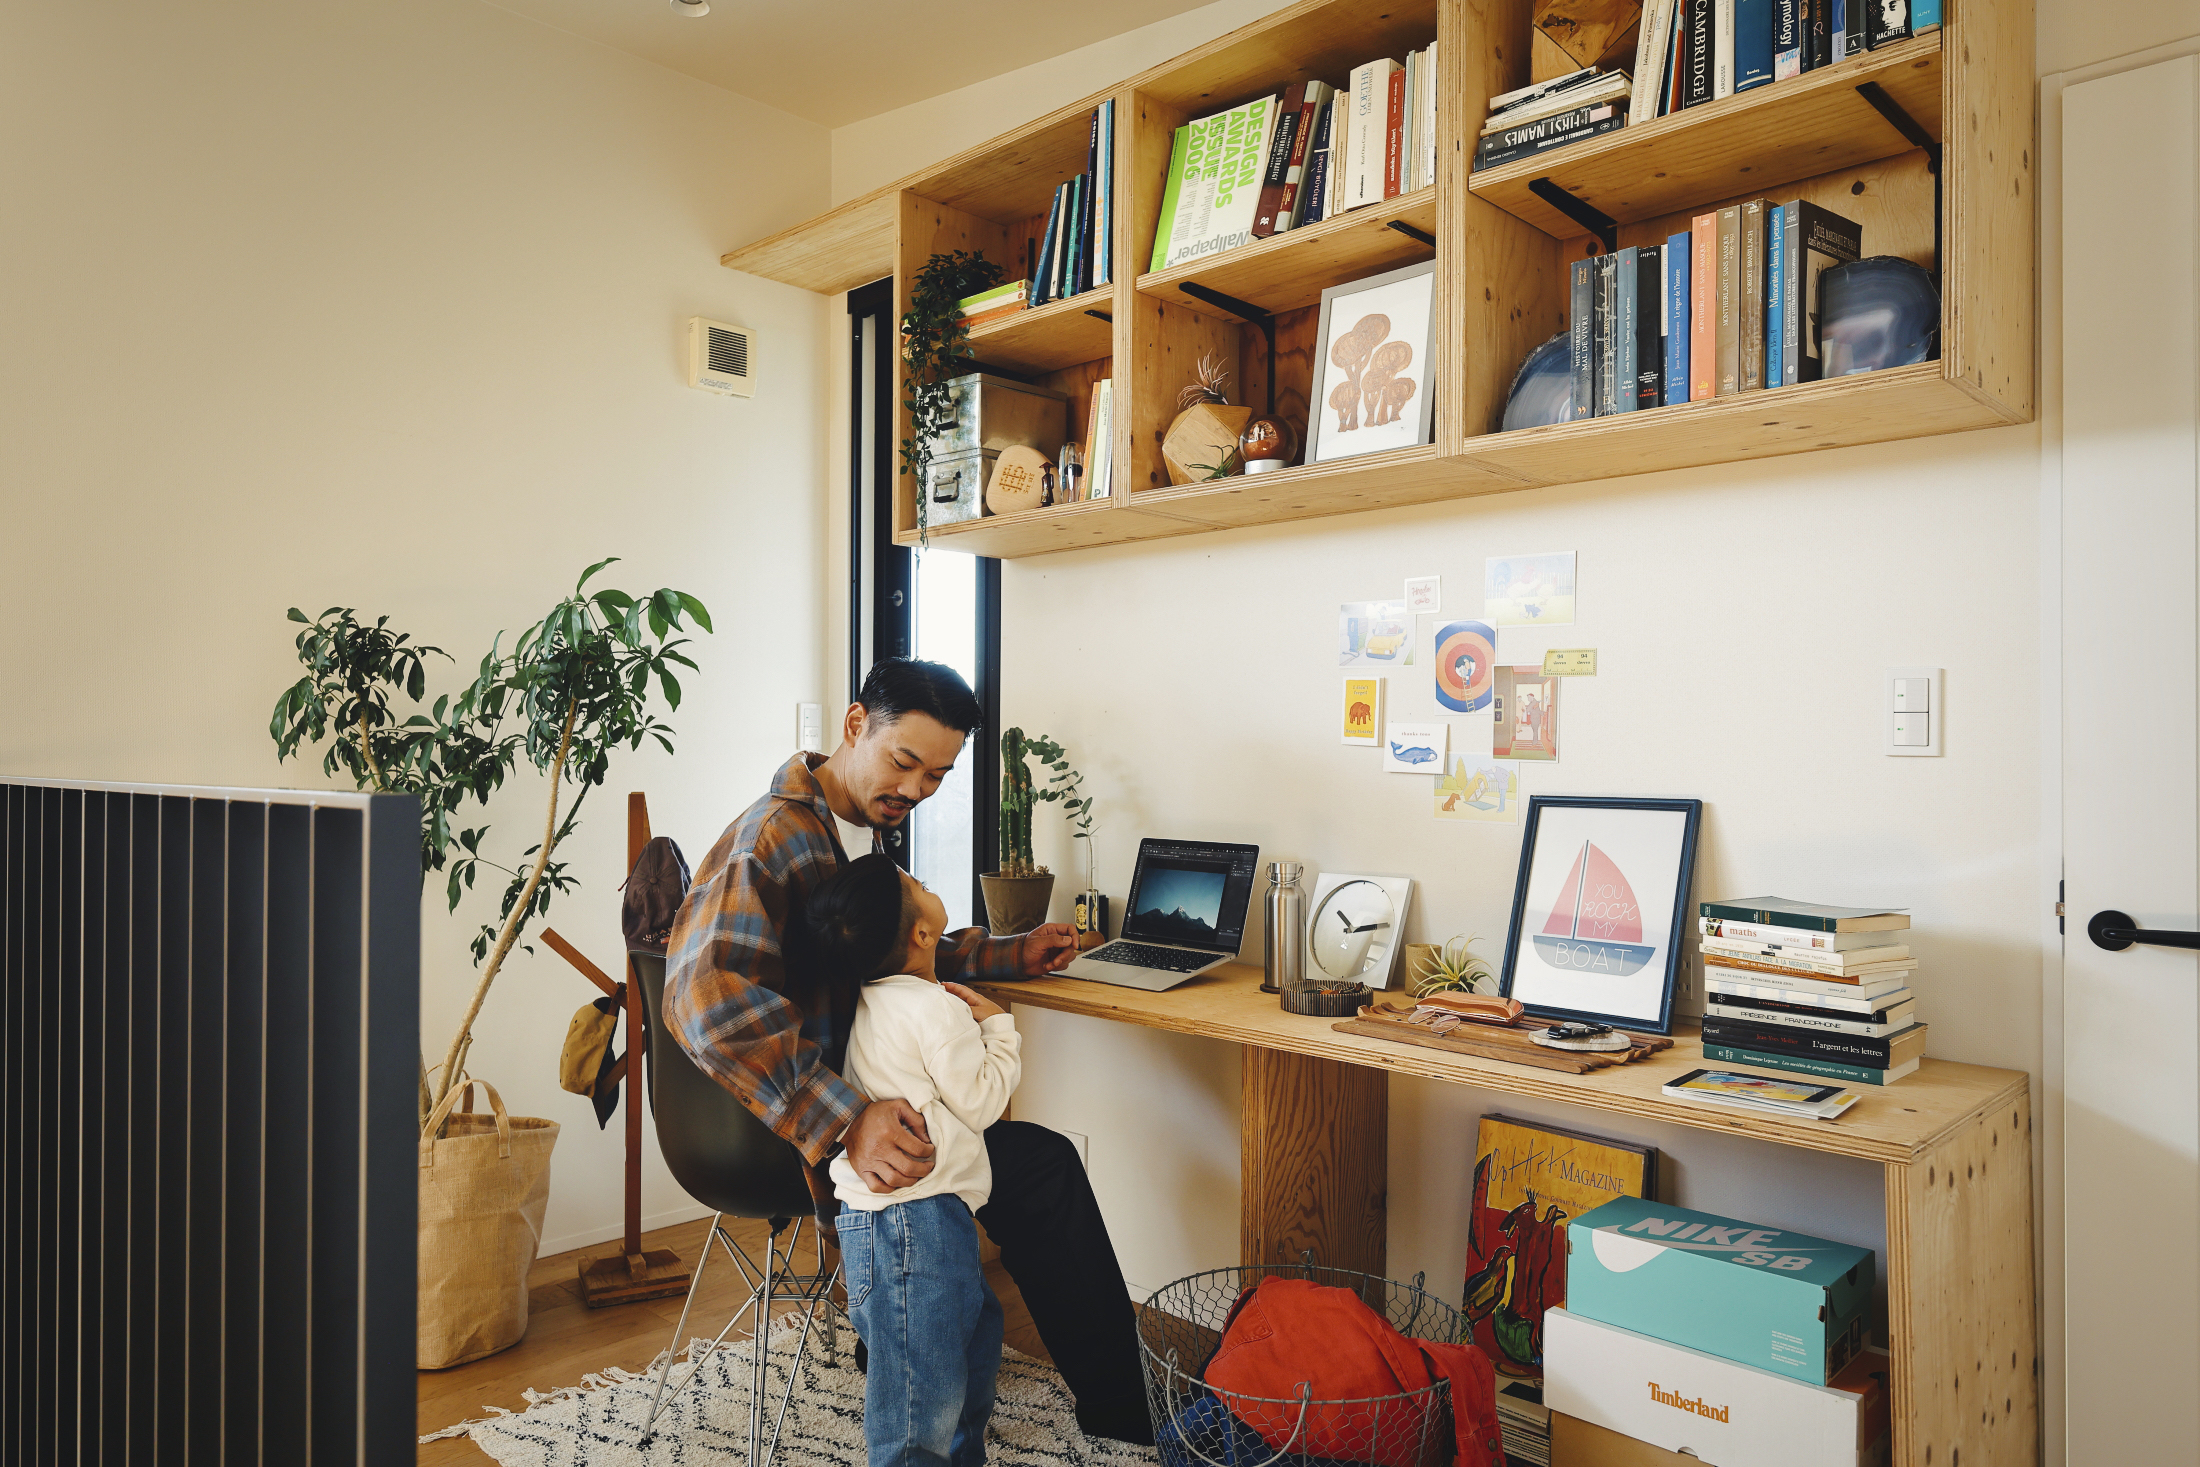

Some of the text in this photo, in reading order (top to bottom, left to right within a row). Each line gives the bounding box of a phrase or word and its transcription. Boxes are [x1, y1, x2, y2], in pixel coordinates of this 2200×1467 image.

[1779, 0, 1794, 44] ymology
[1875, 26, 1906, 41] HACHETTE
[1693, 0, 1707, 96] CAMBRIDGE
[1359, 69, 1370, 116] GOETHE
[1635, 72, 1646, 118] DIALOGUES
[1237, 99, 1268, 188] DESIGN
[1501, 114, 1582, 147] FIRST NAMES
[1184, 121, 1209, 181] 2006
[1200, 114, 1228, 183] ISSUE
[1214, 111, 1247, 209] AWARDS
[1768, 212, 1781, 308] Minorités dans la pensée
[1673, 268, 1681, 287] l'histoire
[1673, 296, 1681, 310] règne
[1581, 314, 1589, 339] VIVRE
[1581, 340, 1588, 351] DE
[1594, 882, 1624, 900] YOU
[1581, 901, 1636, 921] ROCK
[1591, 920, 1618, 937] MY
[1729, 926, 1758, 938] maths
[1553, 942, 1632, 972] BOAT
[1788, 960, 1812, 969] MIGRATION
[1740, 1010, 1841, 1029] PRÉSENCE FRANCOPHONE
[1702, 1026, 1720, 1035] Fayard
[1811, 1040, 1841, 1052] L'argent
[1860, 1047, 1883, 1057] lettres
[1559, 1158, 1625, 1195] MAGAZINE
[1626, 1216, 1783, 1249] NIKE
[1731, 1250, 1814, 1271] SB
[1647, 1380, 1729, 1423] Timberland
